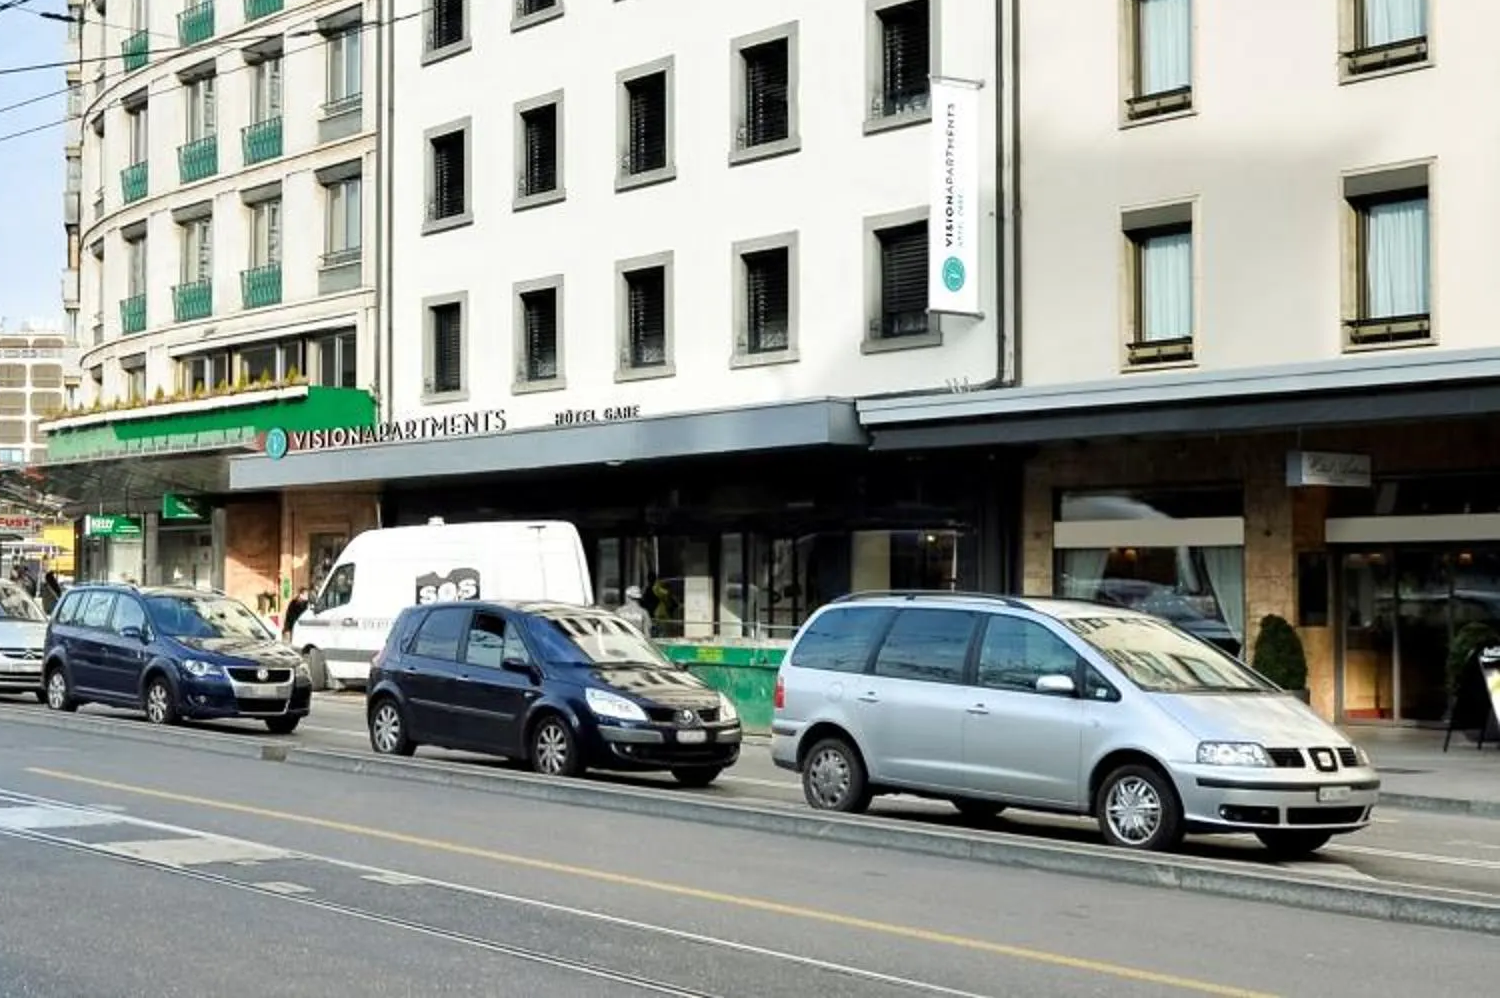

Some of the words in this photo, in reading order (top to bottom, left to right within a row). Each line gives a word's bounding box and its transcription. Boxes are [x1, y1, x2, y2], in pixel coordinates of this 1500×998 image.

[945, 103, 956, 248] VISIONAPARTMENTS
[293, 409, 507, 450] VISIONAPARTMENTS
[419, 578, 478, 604] SOS
